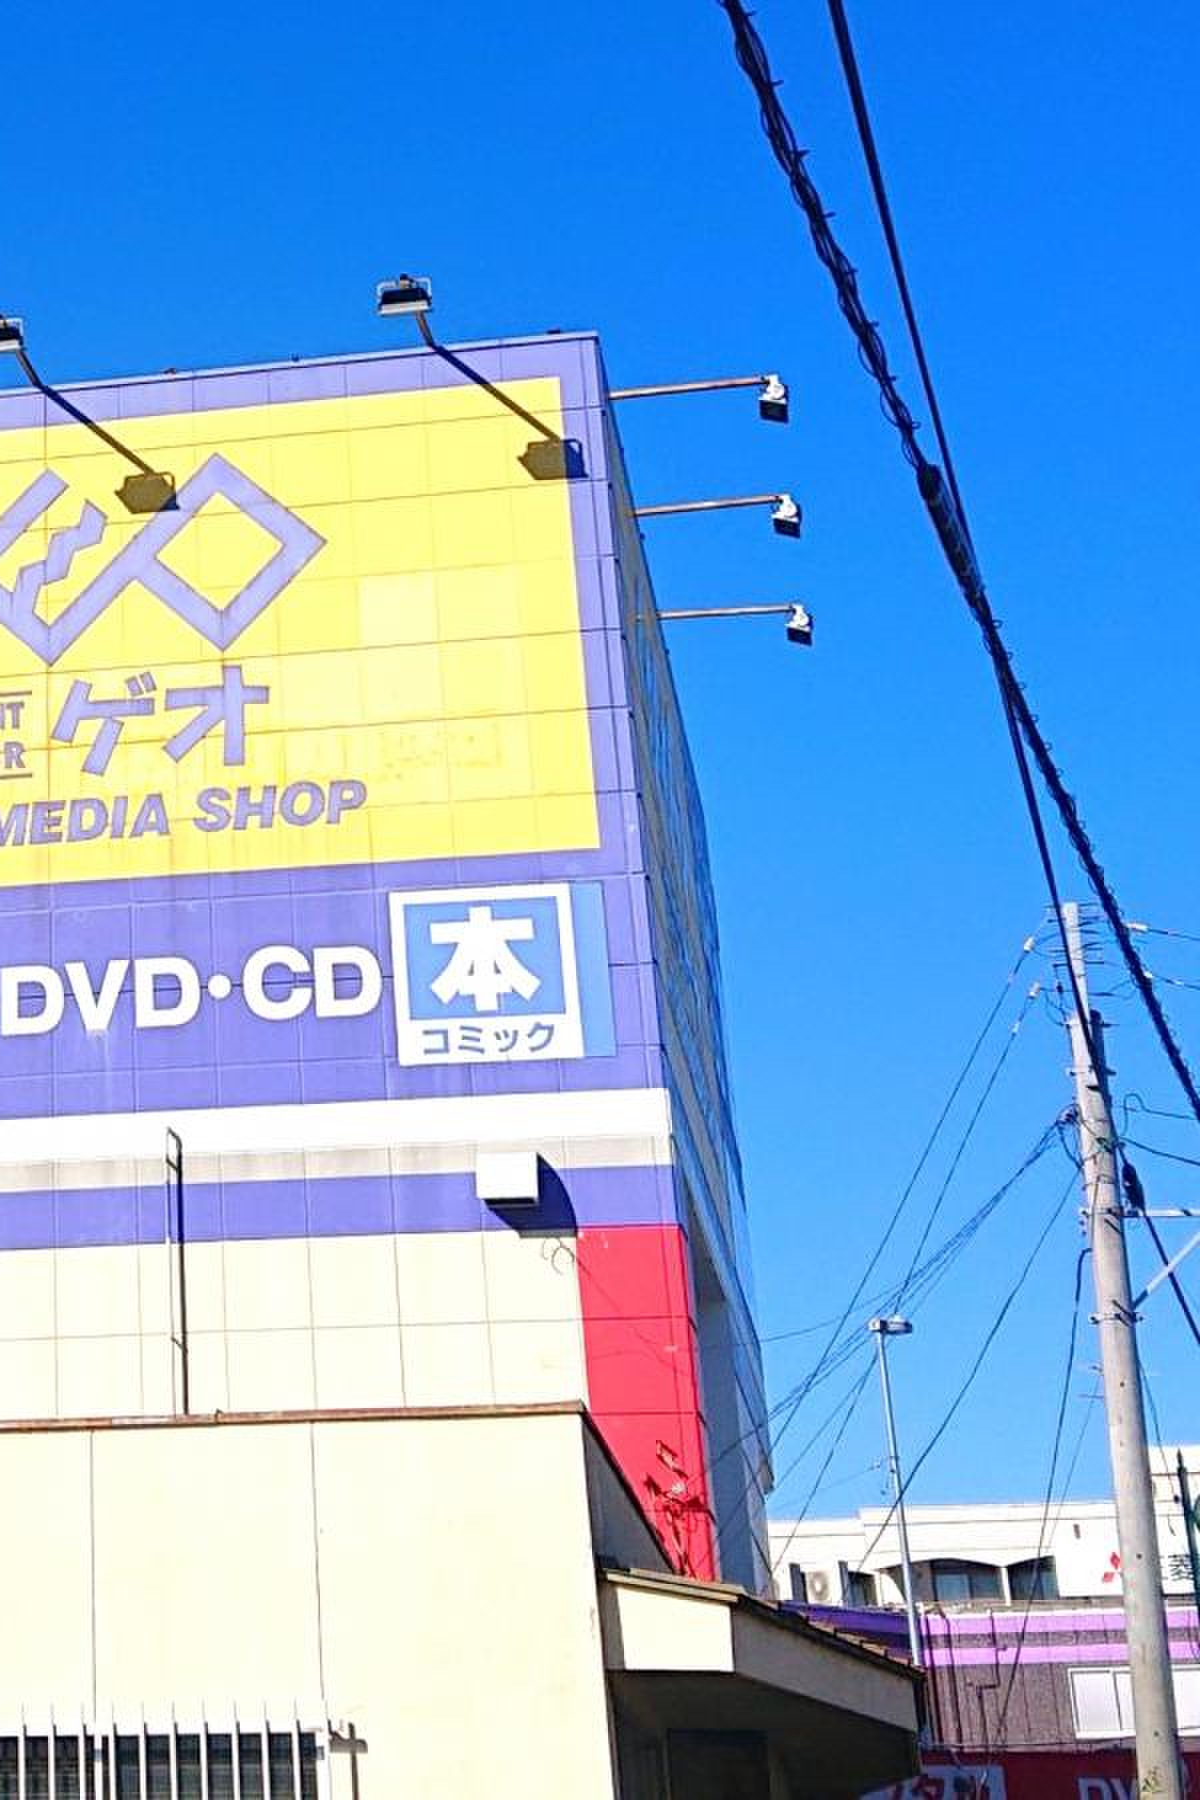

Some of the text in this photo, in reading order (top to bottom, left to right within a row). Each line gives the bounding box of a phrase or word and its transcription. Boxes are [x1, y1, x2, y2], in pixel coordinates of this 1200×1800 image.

[51, 664, 270, 777] ゲオ
[192, 778, 368, 833] SHOP
[430, 906, 541, 1012] 本
[422, 1021, 556, 1056] コミック
